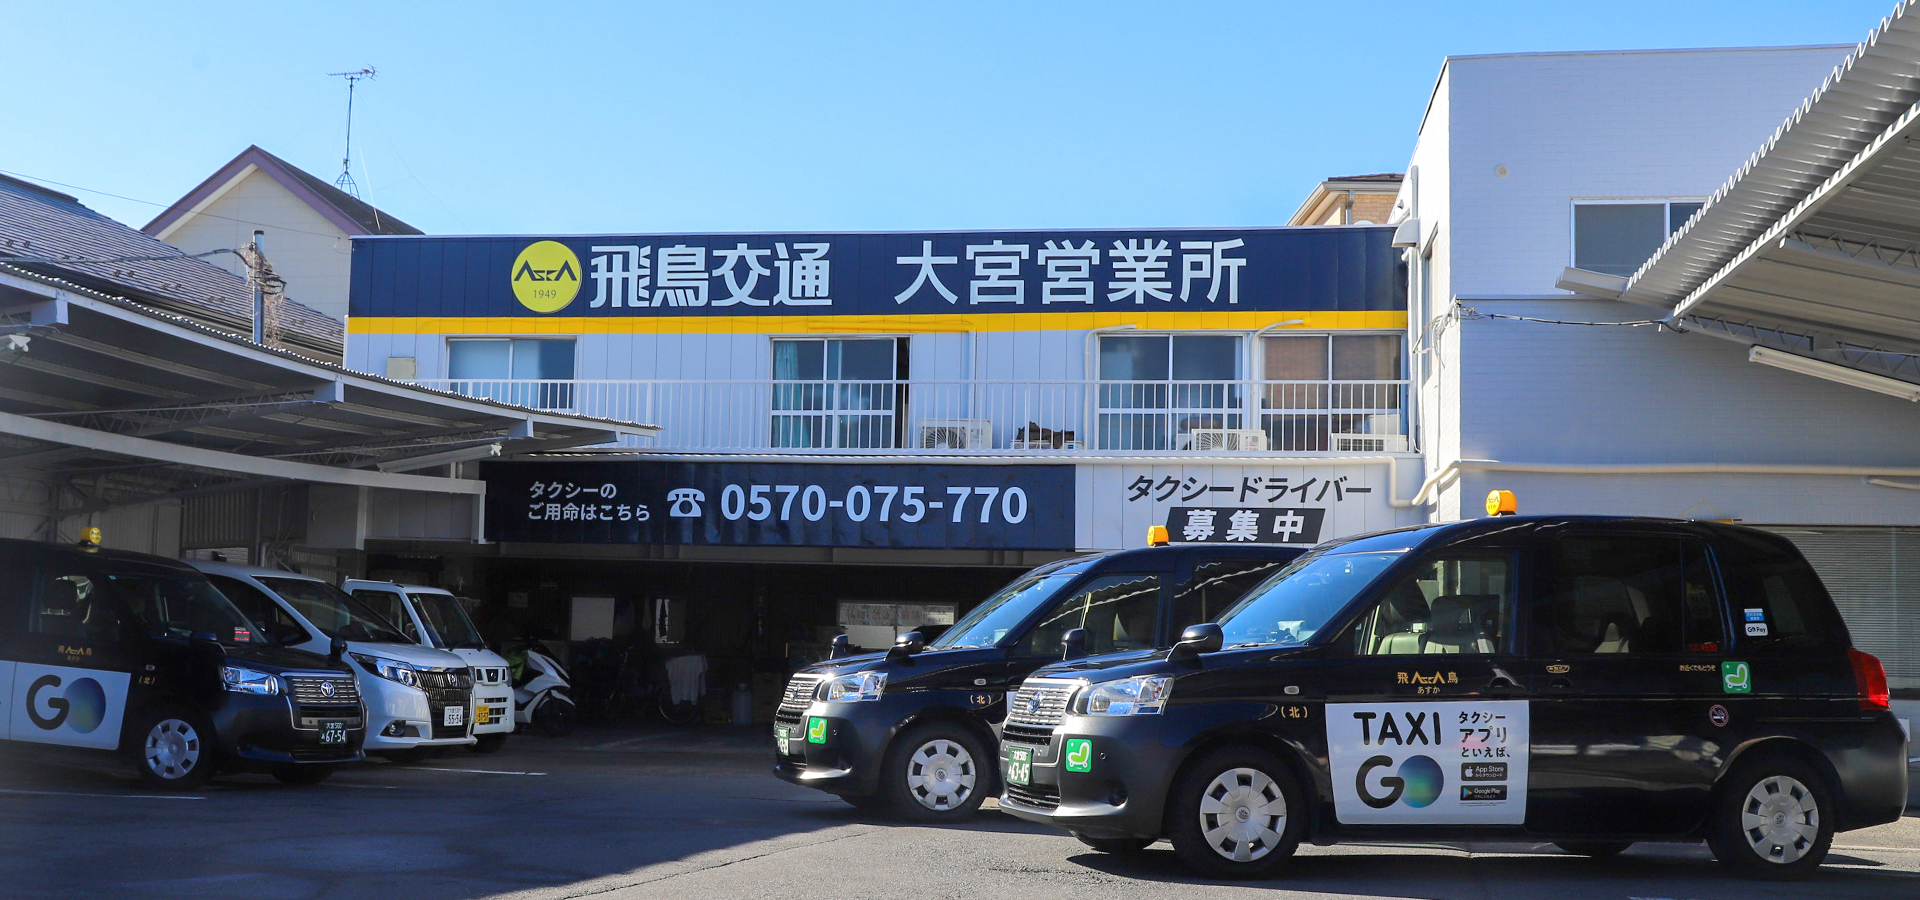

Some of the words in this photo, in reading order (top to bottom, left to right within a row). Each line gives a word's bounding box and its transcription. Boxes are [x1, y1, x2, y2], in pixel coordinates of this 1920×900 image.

[590, 242, 833, 308] 飛鳥交通
[894, 238, 1247, 305] 大宮営業所
[533, 289, 557, 299] 1949
[529, 481, 617, 499] タクシーの
[1127, 475, 1372, 502] タクシードライバー
[528, 501, 650, 522] ご用命はこちら
[721, 483, 1028, 524] 0570-075-770
[1182, 509, 1305, 543] 募集中
[1417, 686, 1441, 695] あすか
[1459, 710, 1506, 724] タクシー
[1353, 711, 1442, 746] TAXI
[1460, 726, 1507, 743] アプリ
[1461, 746, 1511, 758] といえば、
[1489, 765, 1504, 773] Store
[1356, 754, 1445, 809] GO
[1474, 787, 1490, 795] Google
[1491, 787, 1501, 795] Play
